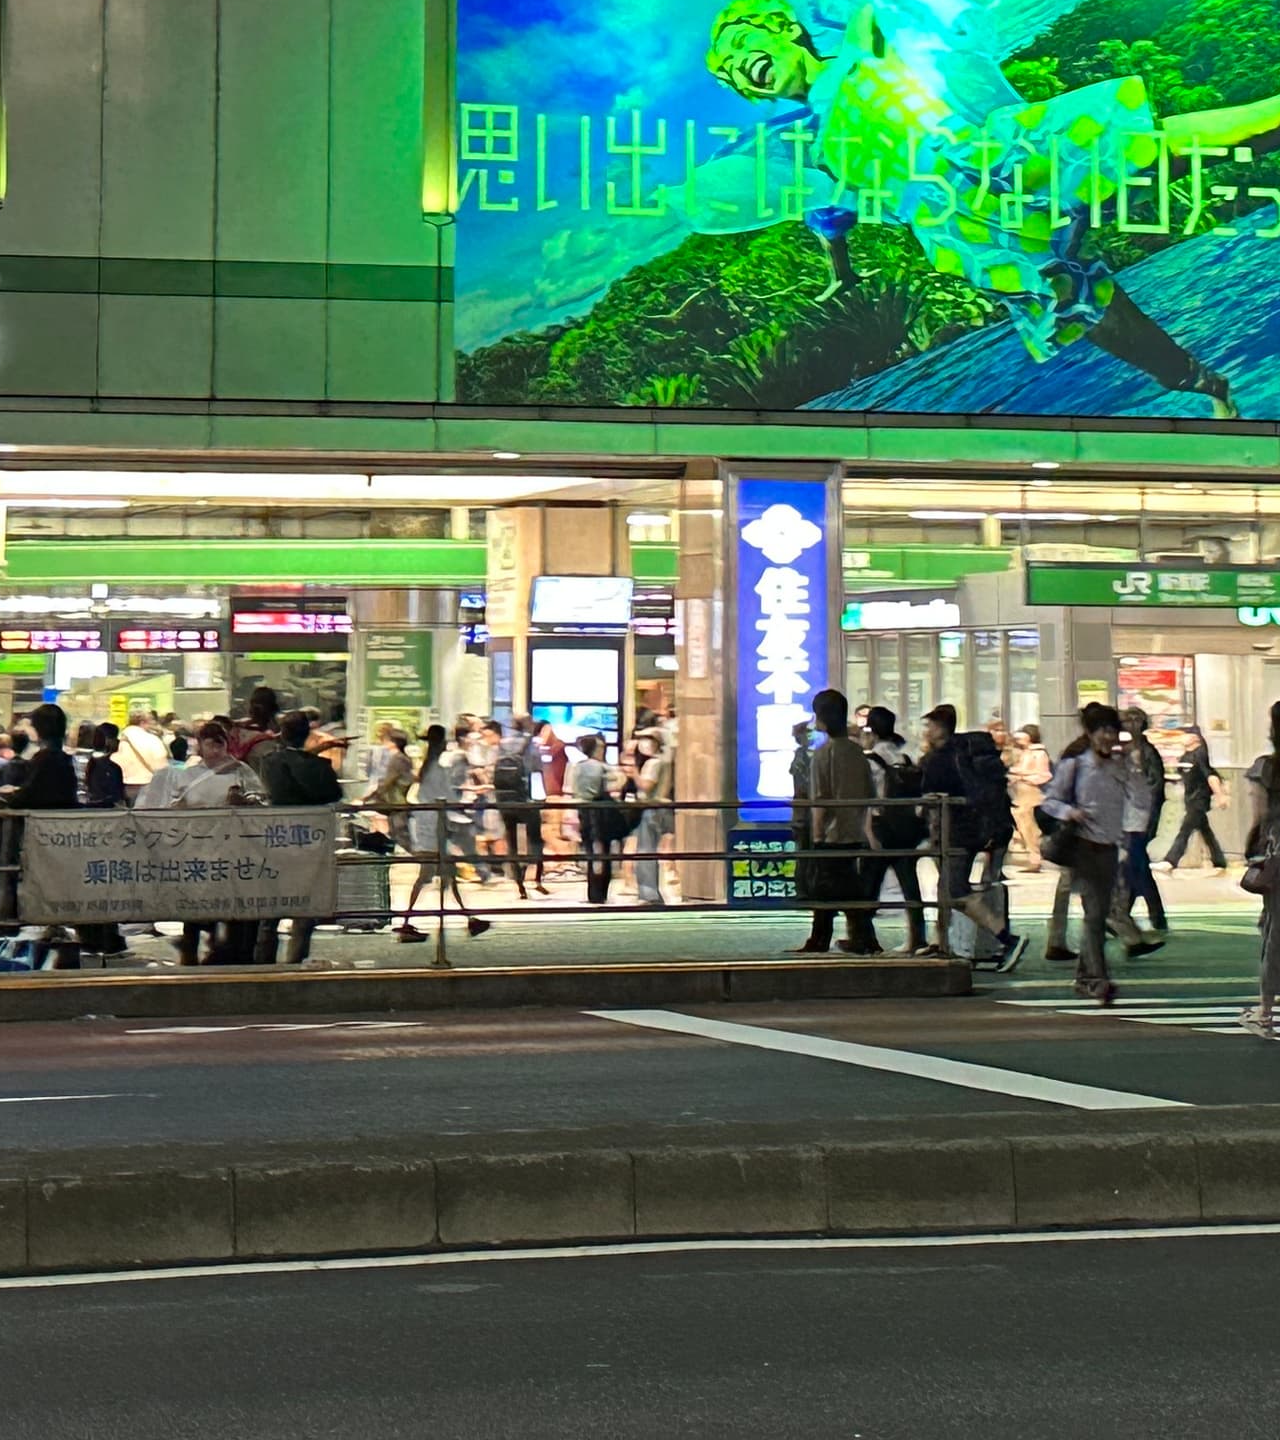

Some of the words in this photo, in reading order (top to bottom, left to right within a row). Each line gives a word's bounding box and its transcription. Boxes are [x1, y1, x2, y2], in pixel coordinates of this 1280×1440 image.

[83, 857, 280, 885] 乗降は出来ません
